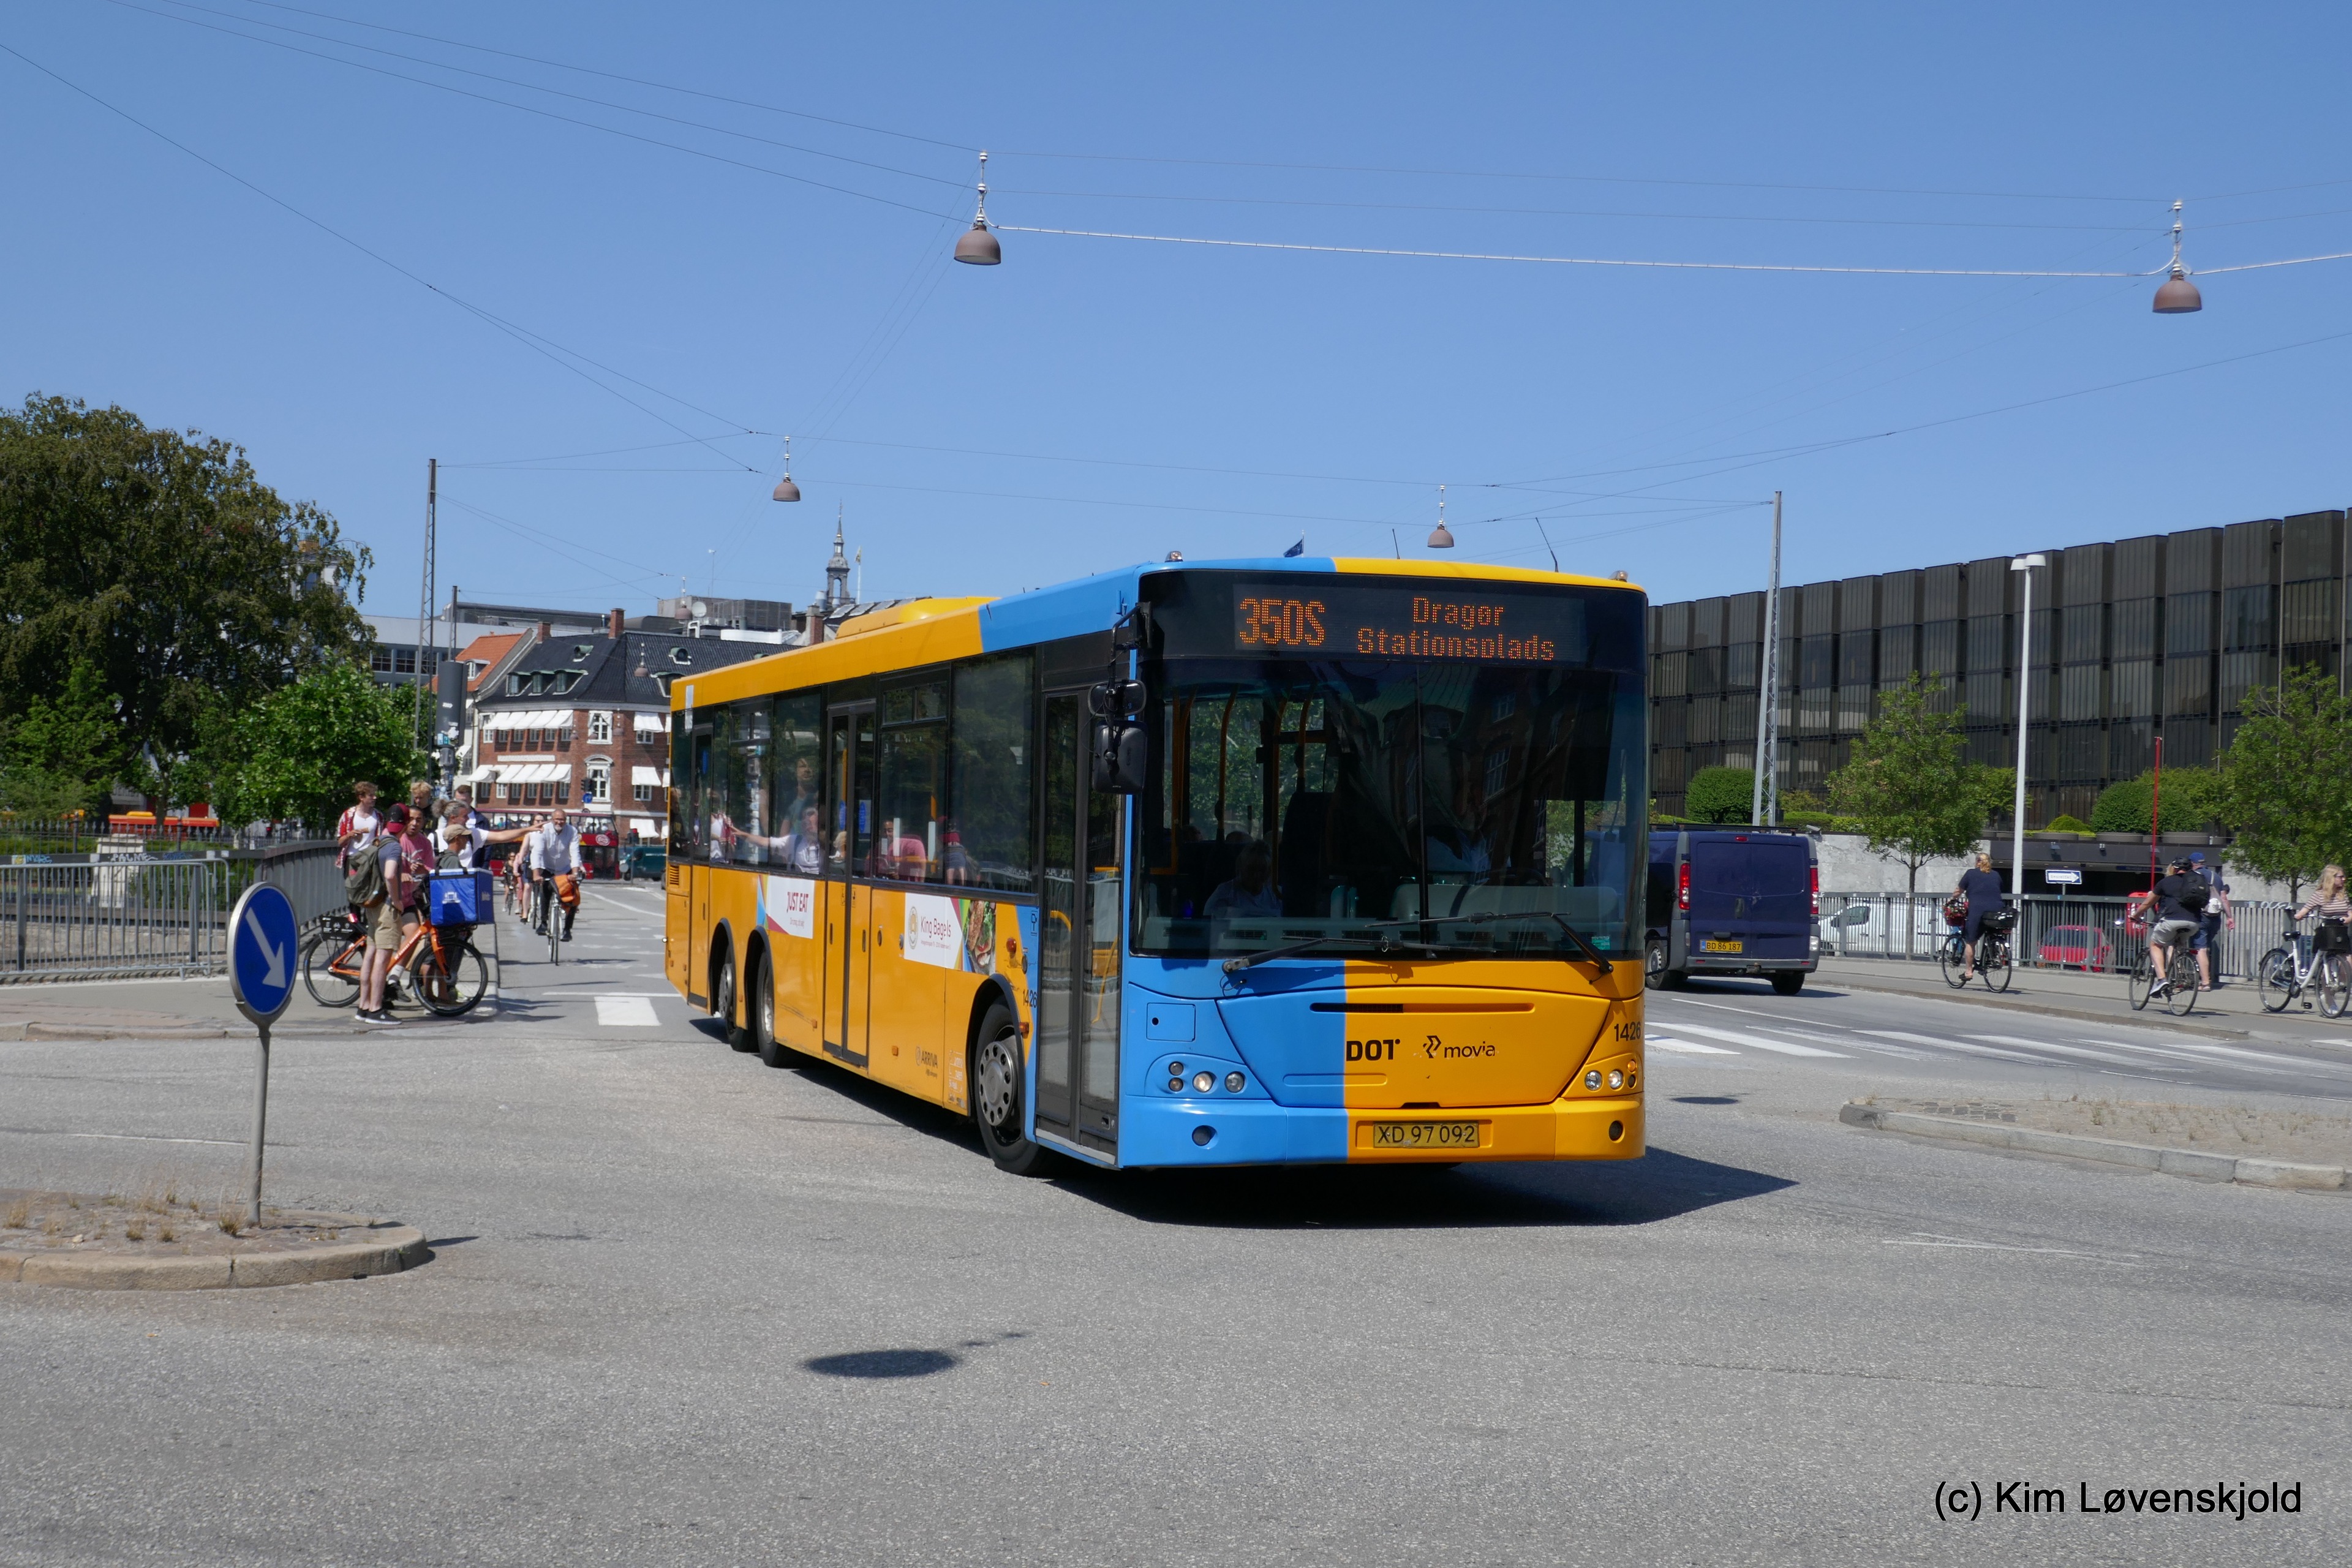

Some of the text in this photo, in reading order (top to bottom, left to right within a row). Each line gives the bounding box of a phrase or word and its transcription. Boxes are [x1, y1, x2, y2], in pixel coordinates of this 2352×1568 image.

[1240, 597, 1325, 646] 350S
[1413, 597, 1504, 630] Dragør
[786, 891, 809, 913] JUST EAT
[921, 916, 951, 940] King Bagels
[1022, 989, 1038, 1008] 1426
[1614, 1021, 1642, 1042] 1426
[921, 1050, 938, 1069] ARRIVA
[1346, 1039, 1400, 1062] DOT
[1444, 1041, 1495, 1058] movia
[1378, 1125, 1475, 1144] XD 97 092
